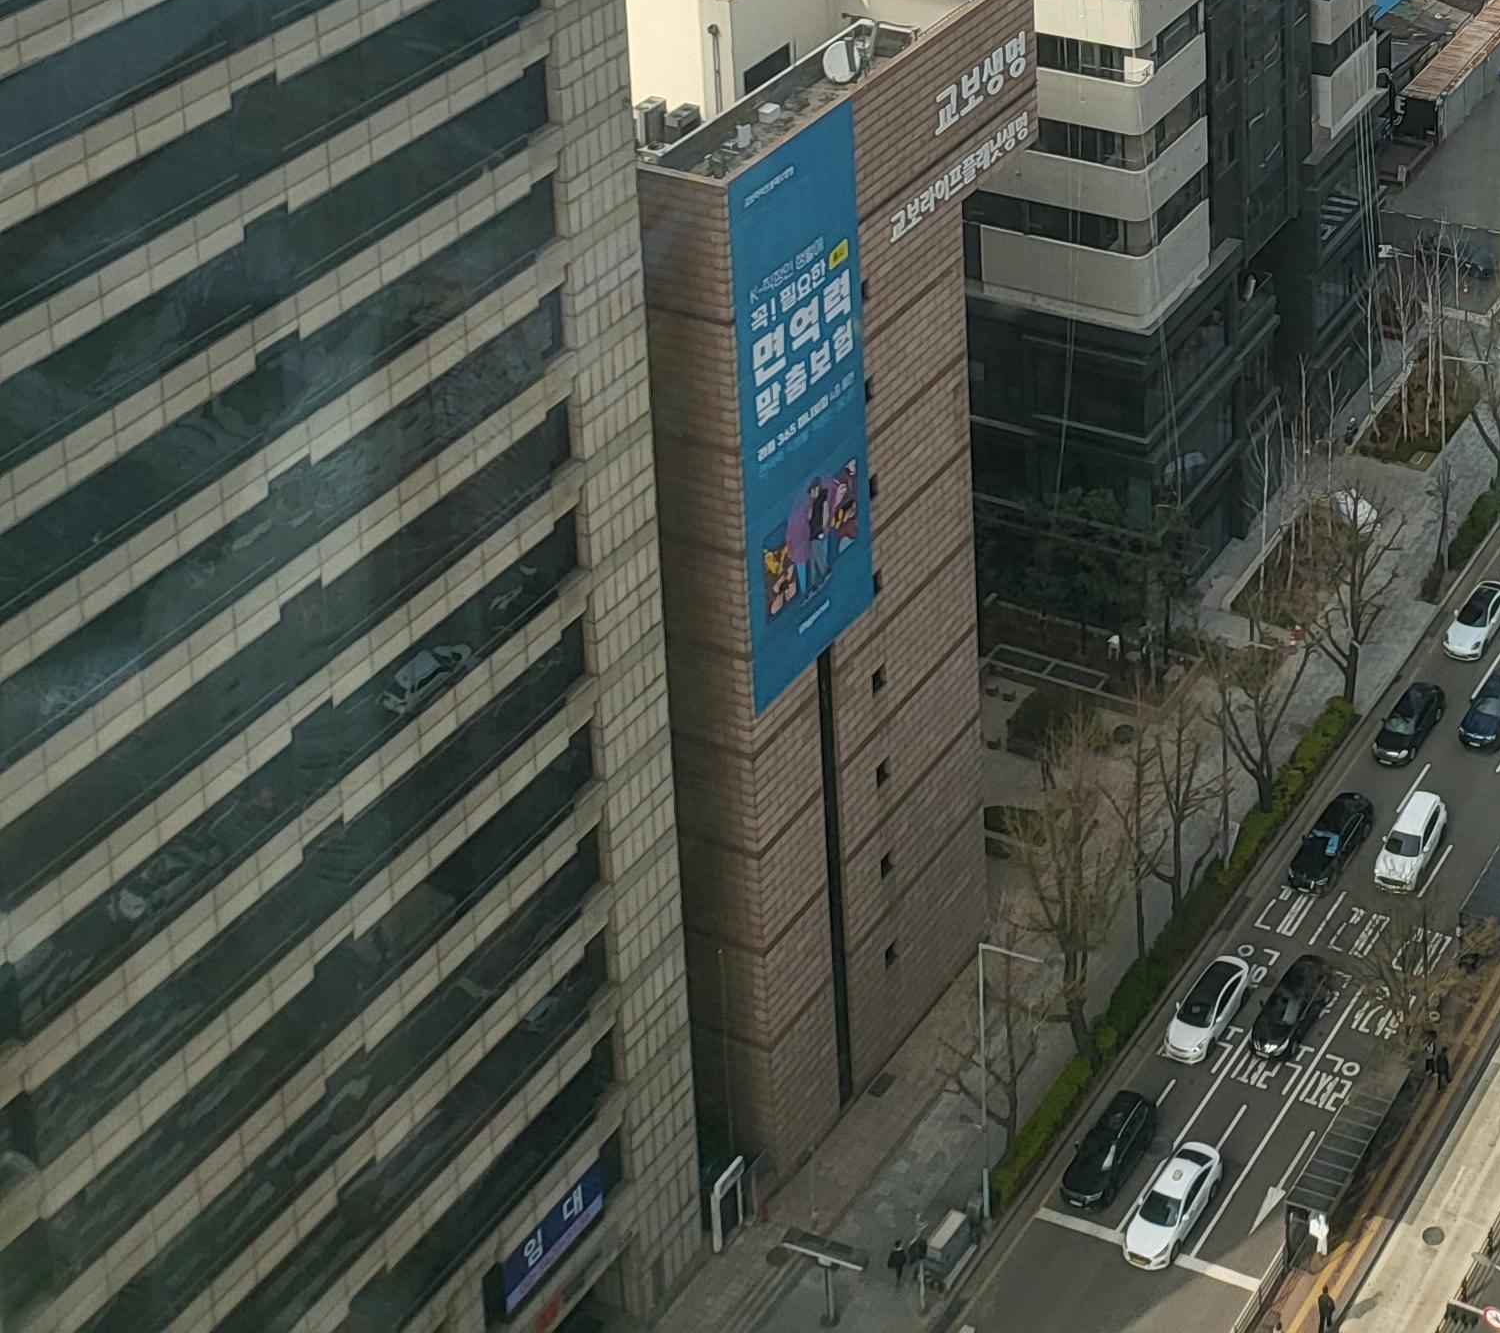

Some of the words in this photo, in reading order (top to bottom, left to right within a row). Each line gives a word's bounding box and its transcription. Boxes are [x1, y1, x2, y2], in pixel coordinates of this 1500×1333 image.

[934, 30, 1026, 136] 교보생명
[889, 111, 1029, 244] 교보라이프플래닛생명
[750, 296, 777, 332] 꼭!
[779, 258, 826, 313] 필요한
[752, 268, 852, 388] 면역력
[755, 318, 855, 428] 맞춤보험
[776, 421, 796, 447] 365
